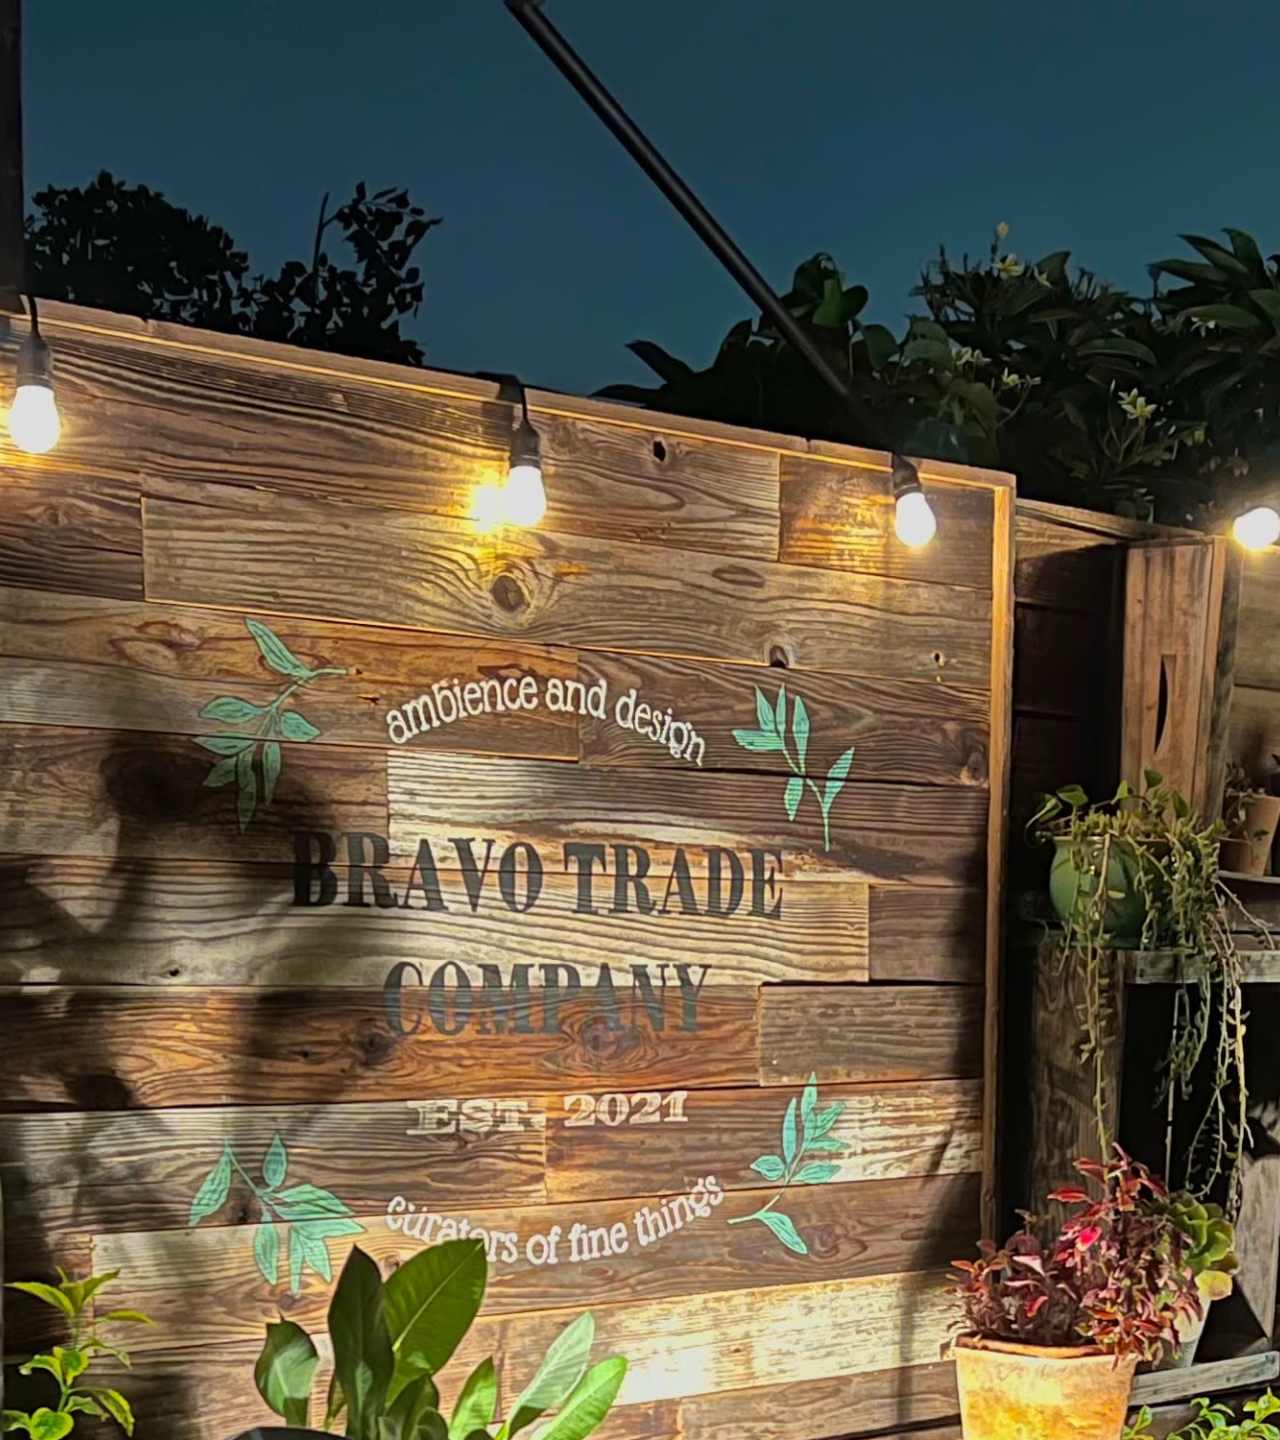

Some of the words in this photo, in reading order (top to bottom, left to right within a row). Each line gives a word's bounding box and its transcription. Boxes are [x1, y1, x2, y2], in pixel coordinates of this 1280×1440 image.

[385, 675, 538, 744] ambience
[545, 677, 607, 720] and
[614, 688, 706, 767] design
[289, 831, 543, 913] BRAVO
[564, 842, 784, 921] TRADE
[382, 961, 712, 1035] COMPANY
[406, 1099, 547, 1135] EST.
[563, 1091, 689, 1127] 2021
[526, 1225, 562, 1264] of
[570, 1220, 630, 1263] fine
[633, 1174, 725, 1248] things
